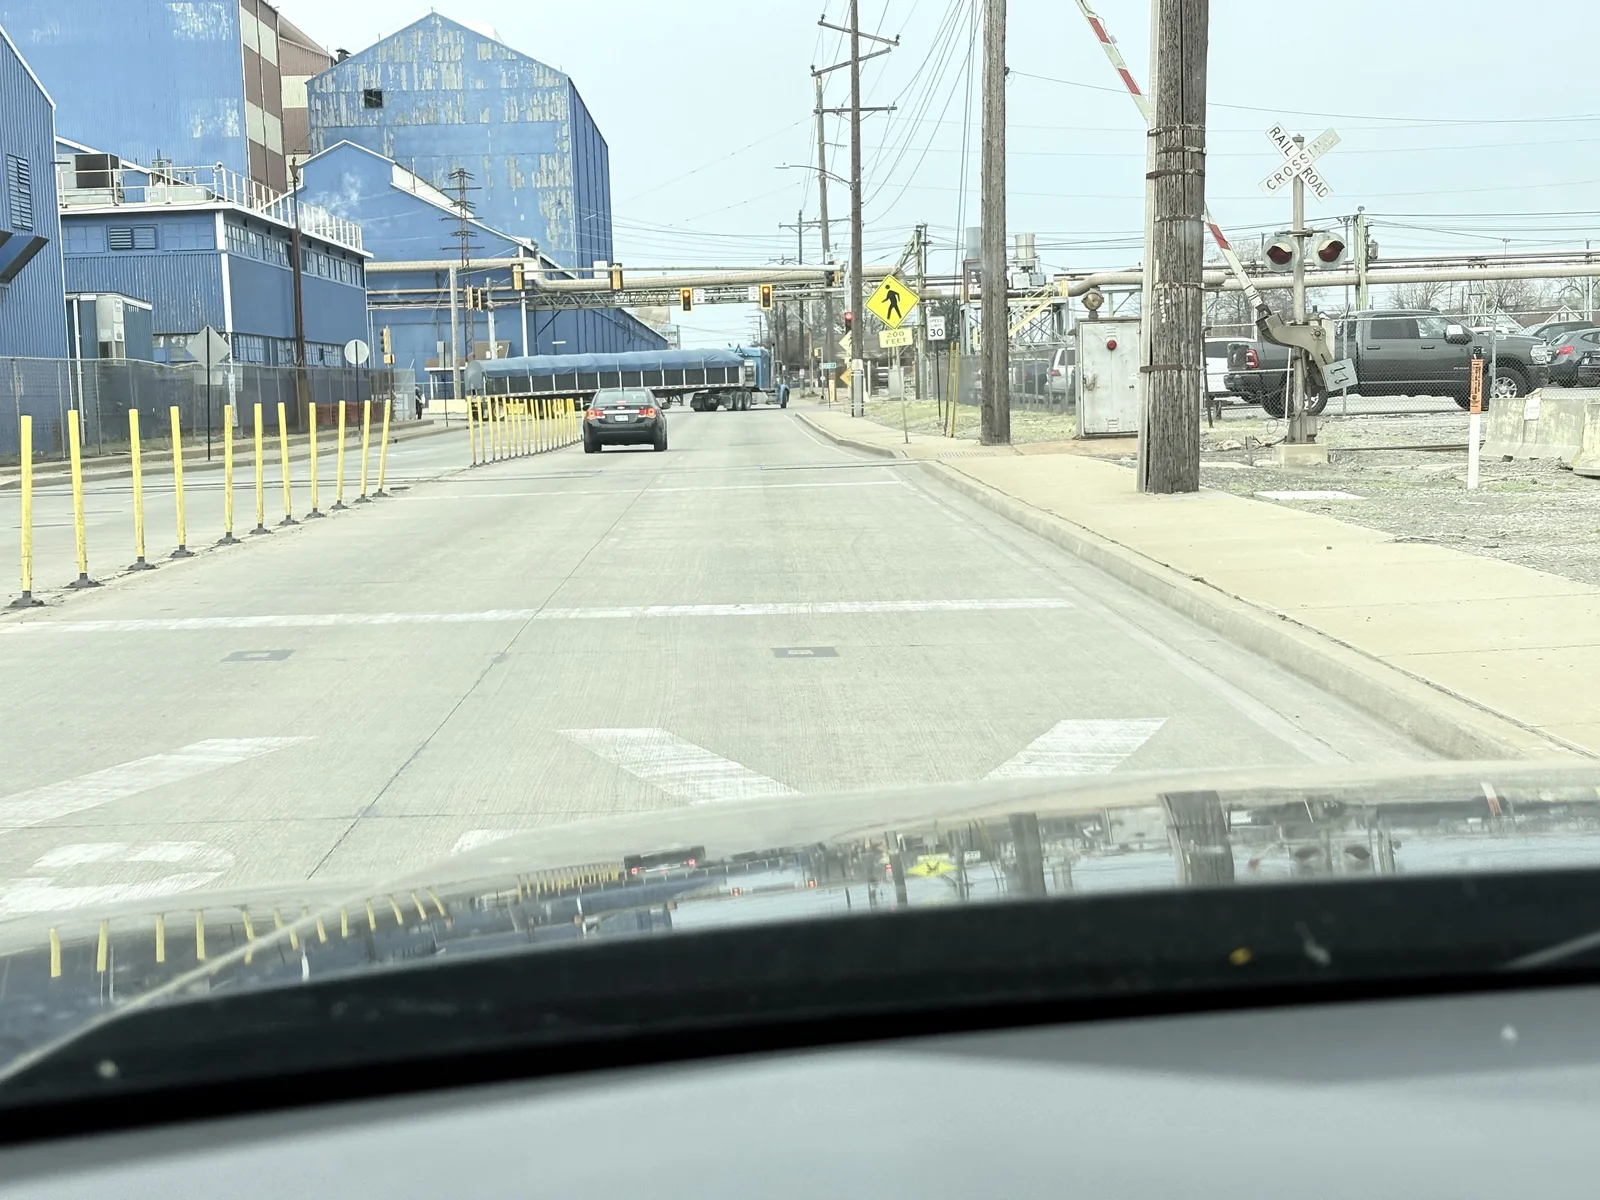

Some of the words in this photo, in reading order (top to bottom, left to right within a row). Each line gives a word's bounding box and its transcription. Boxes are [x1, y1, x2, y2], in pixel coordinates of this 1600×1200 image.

[1269, 126, 1294, 157] RAIL
[1302, 167, 1329, 198] ROAD
[929, 328, 944, 337] 30
[886, 337, 906, 345] FEET
